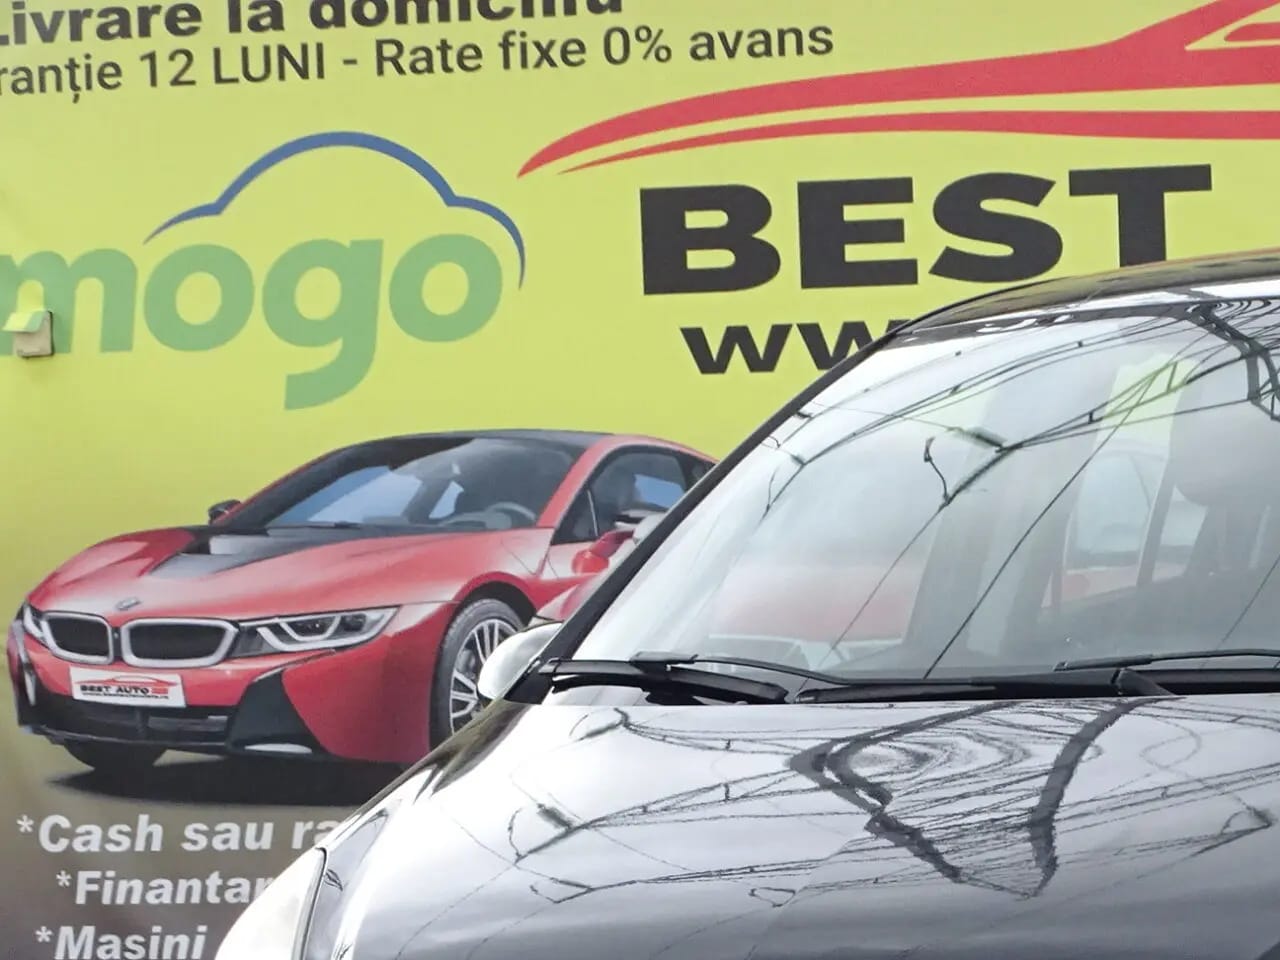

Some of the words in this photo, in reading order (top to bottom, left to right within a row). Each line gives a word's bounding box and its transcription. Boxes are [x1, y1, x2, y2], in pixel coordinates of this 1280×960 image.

[0, 0, 202, 46] ivrare
[226, 0, 285, 34] la
[139, 47, 197, 89] 12
[213, 41, 325, 84] LUNI
[375, 37, 484, 77] Rate
[498, 29, 587, 70] fixe
[603, 24, 673, 65] 0%
[689, 25, 834, 62] avans
[639, 163, 1213, 296] BEST
[0, 234, 504, 410] mogo
[116, 686, 150, 695] AUTO
[181, 821, 274, 852] sau
